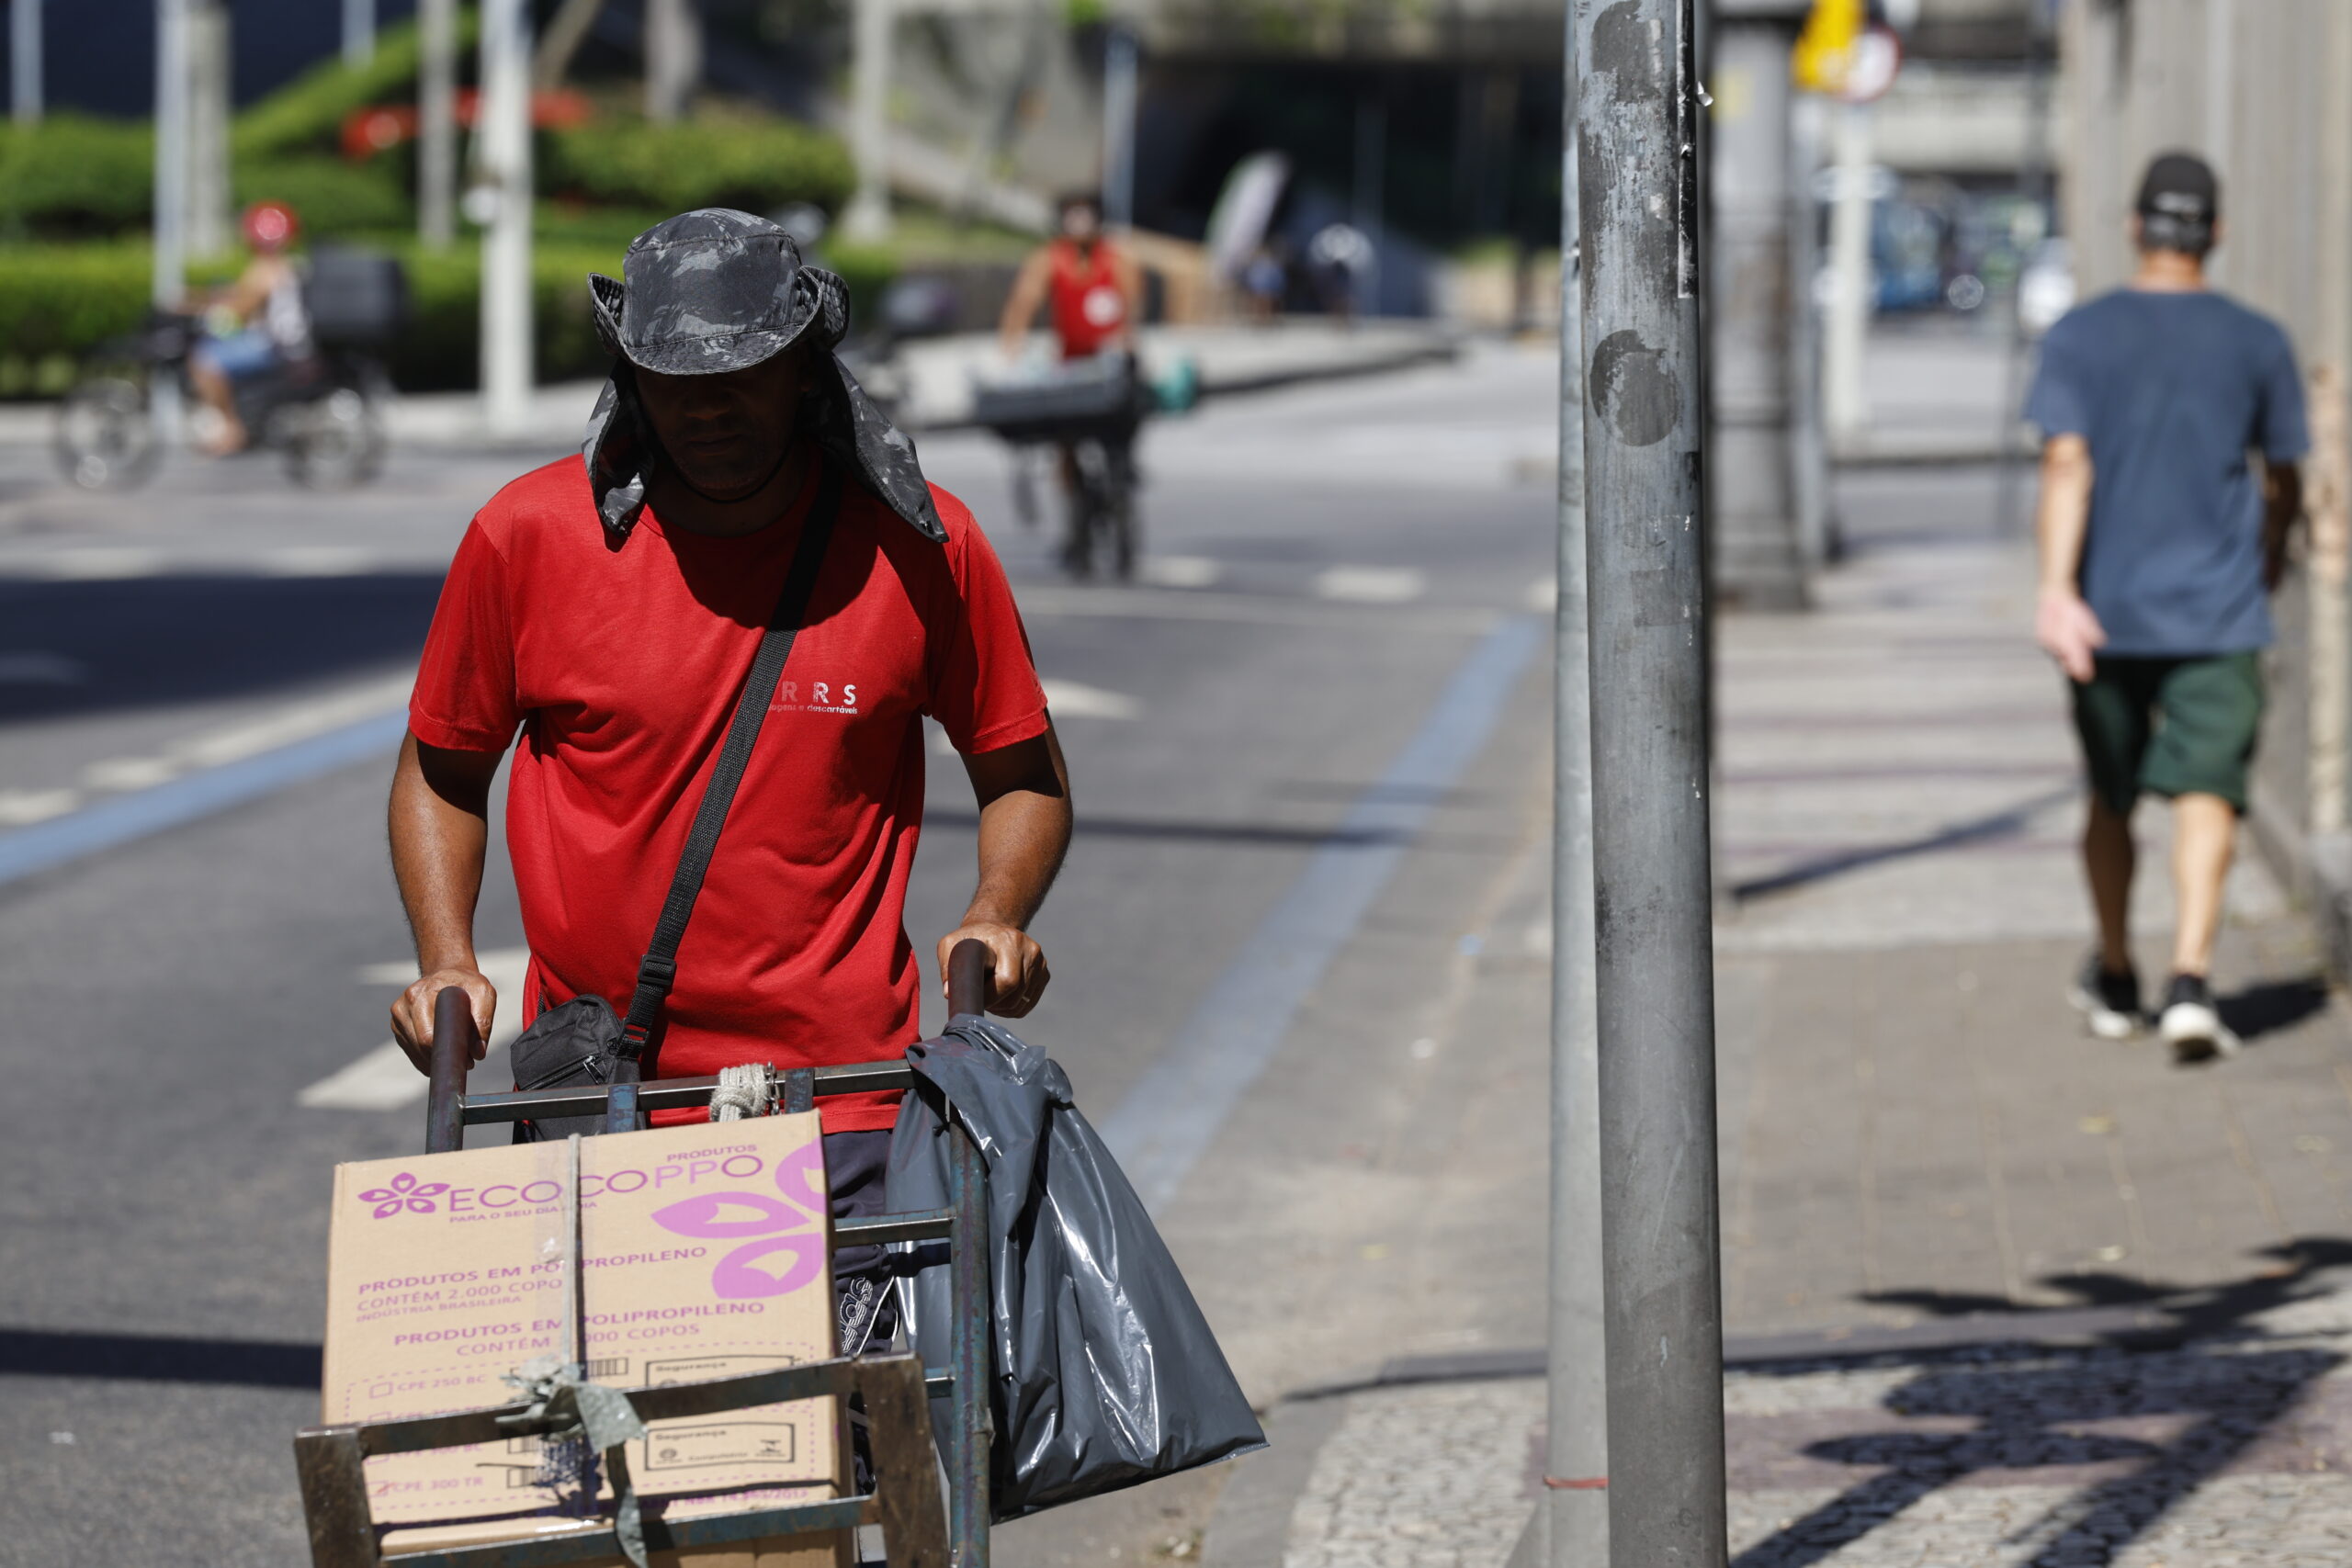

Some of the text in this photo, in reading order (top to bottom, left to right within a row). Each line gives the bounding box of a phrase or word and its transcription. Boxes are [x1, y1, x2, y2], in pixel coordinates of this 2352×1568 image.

[807, 704, 858, 715] descartáveis
[667, 1144, 758, 1163] PRODUTOS
[449, 1213, 487, 1224] PARA
[490, 1212, 501, 1220] O
[504, 1209, 532, 1219] SEU
[536, 1206, 559, 1215] DIA
[358, 1247, 707, 1295] PRODUTOS EM POPROPILENO
[356, 1278, 563, 1312] CONTÉM 2.000 COPO
[356, 1295, 522, 1323] INDÚSTRIA BRASILEIRA
[394, 1322, 523, 1346] PRODUTOS
[456, 1335, 551, 1357] CONTÉM
[627, 1323, 701, 1340] COPOS
[397, 1380, 426, 1392] CPE
[432, 1378, 459, 1389] 250
[655, 1429, 727, 1441] Segurança
